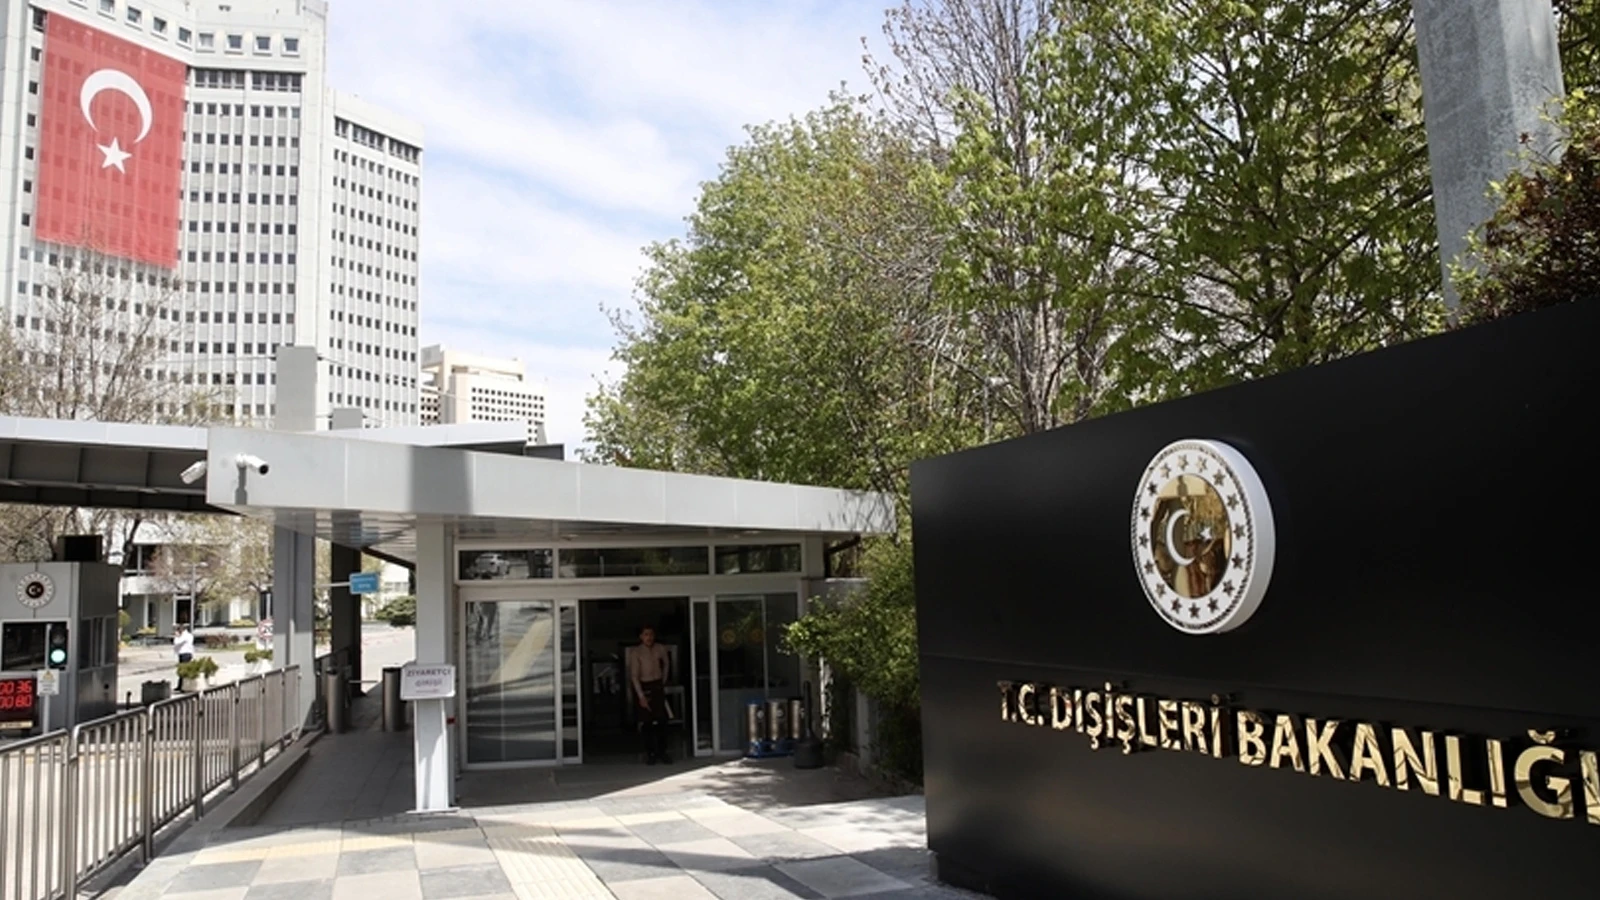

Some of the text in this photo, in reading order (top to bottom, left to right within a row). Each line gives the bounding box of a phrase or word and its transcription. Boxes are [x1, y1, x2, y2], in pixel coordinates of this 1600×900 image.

[997, 680, 1600, 825] T.C. DIŞİŞLERİ BAKANLIĞI
